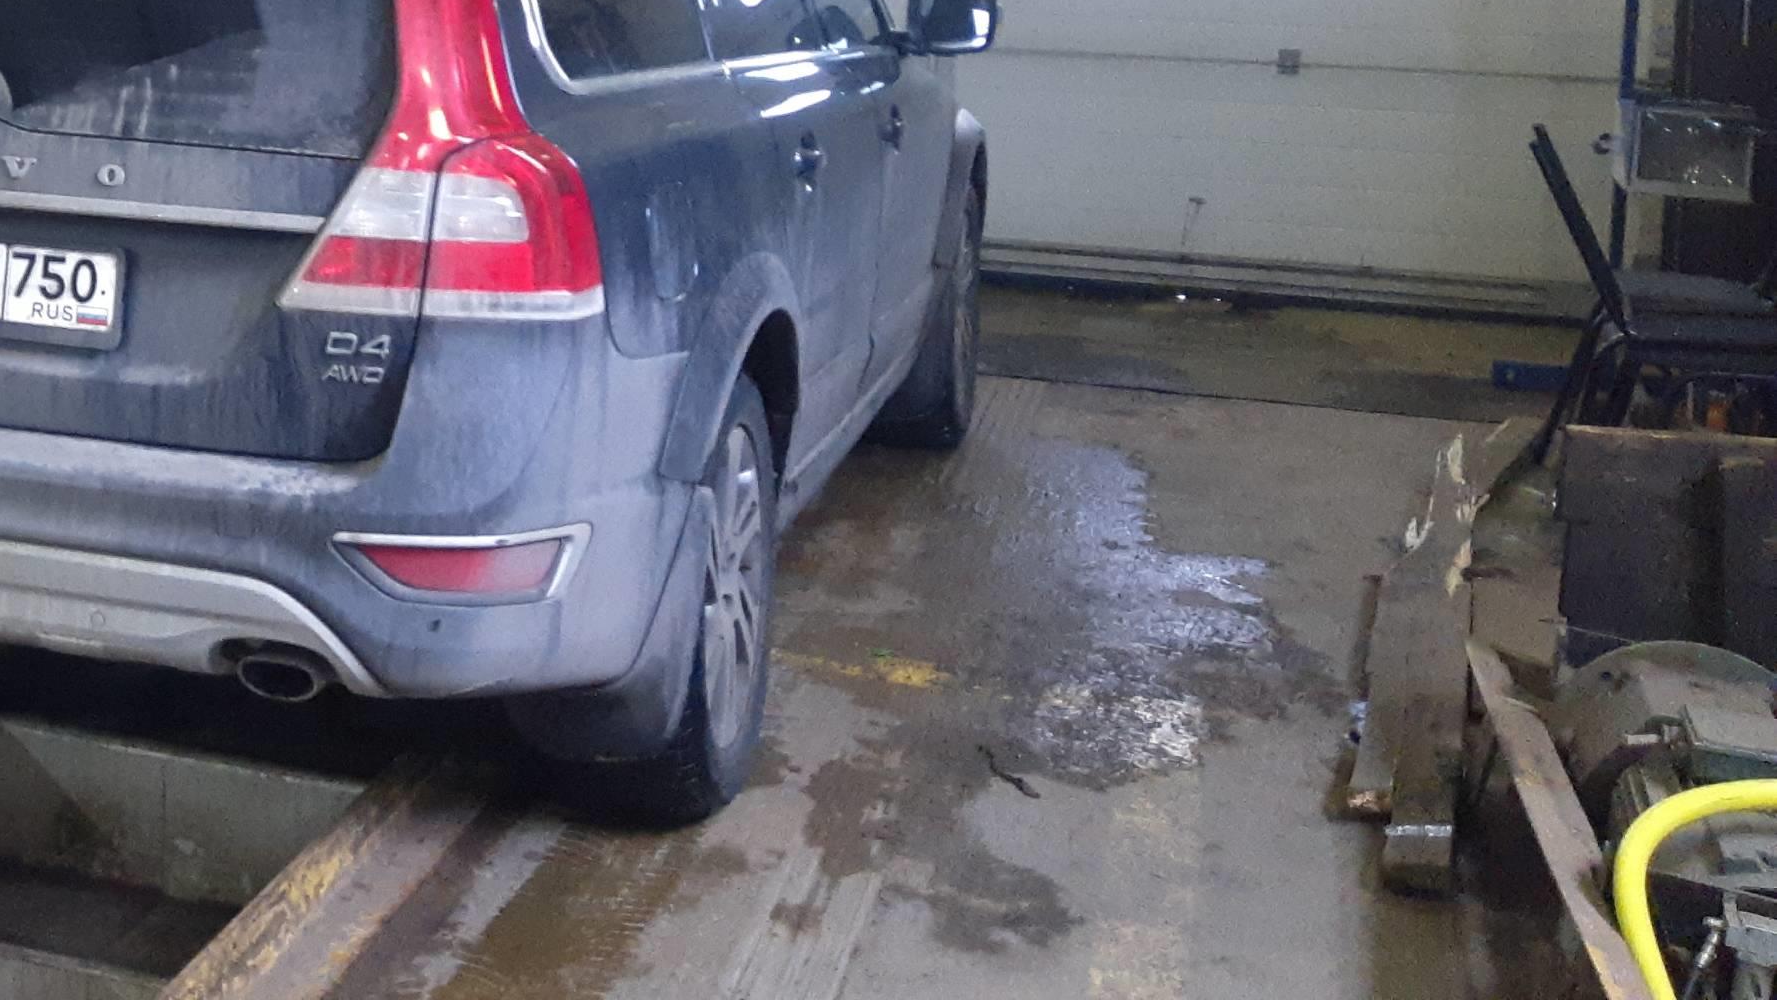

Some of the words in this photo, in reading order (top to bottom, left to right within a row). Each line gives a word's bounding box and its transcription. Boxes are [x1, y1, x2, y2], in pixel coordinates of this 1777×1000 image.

[11, 252, 98, 304] 750
[31, 301, 73, 322] RUS
[325, 331, 391, 359] D4
[322, 364, 385, 385] AWD
